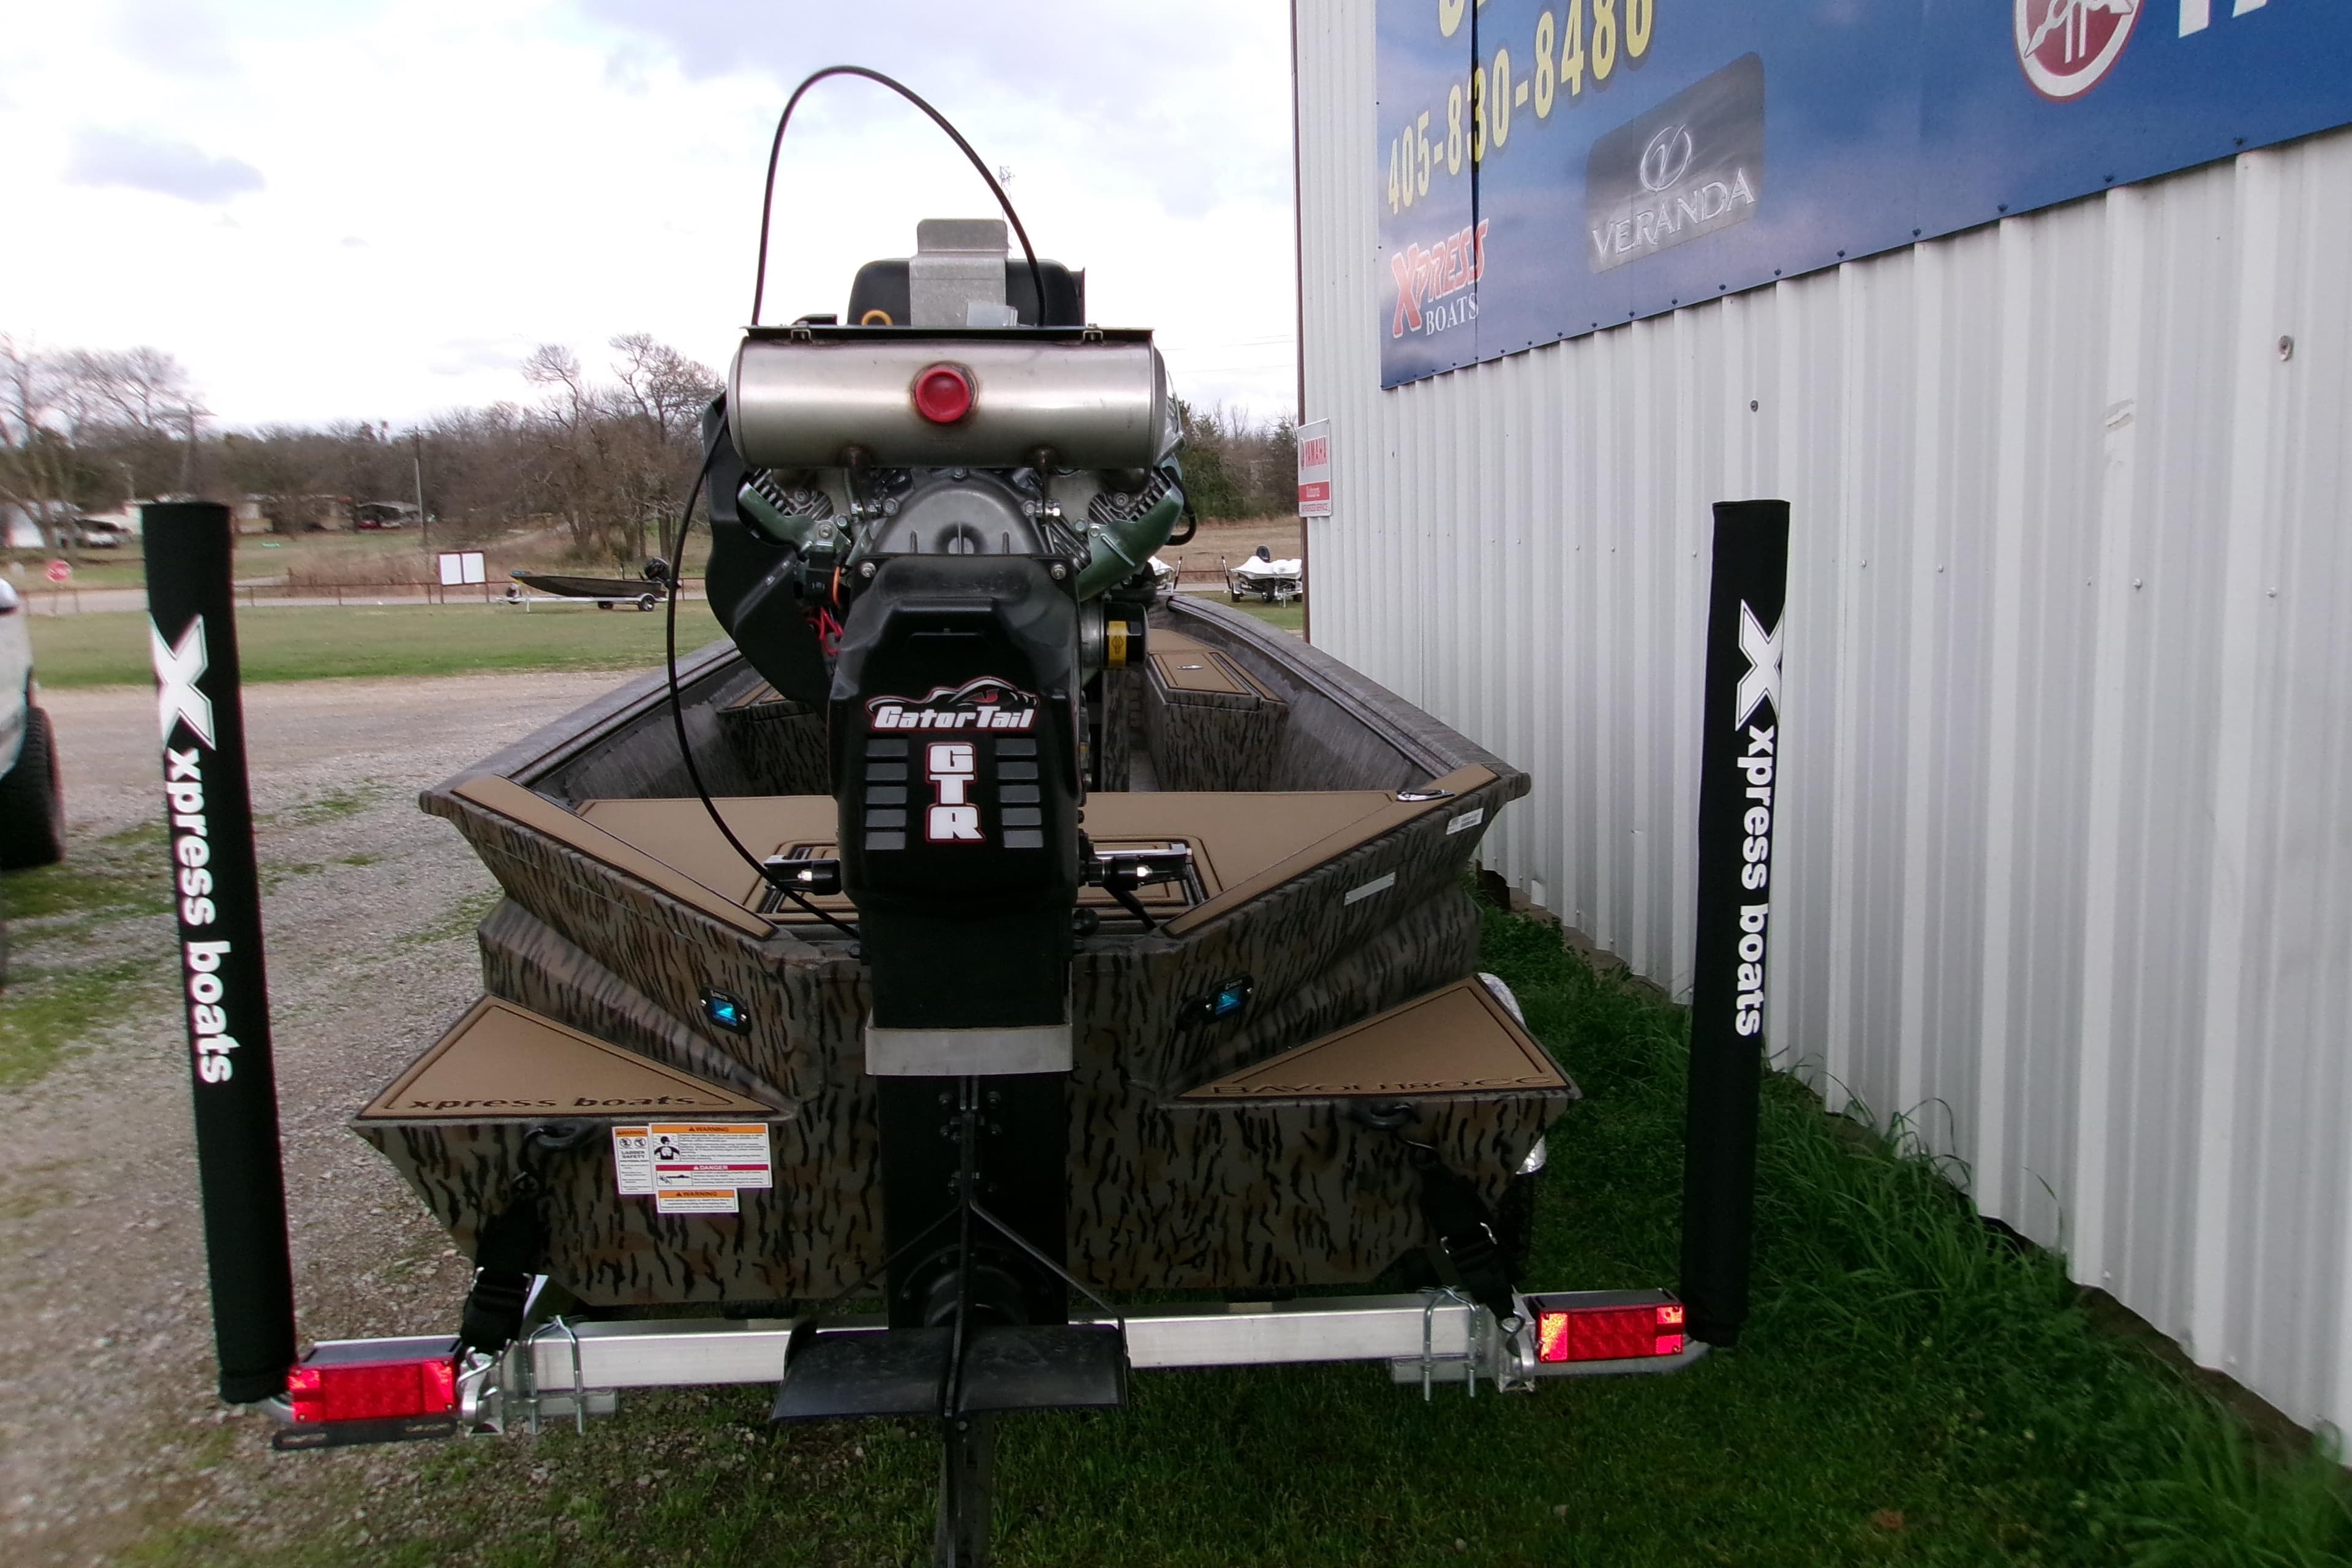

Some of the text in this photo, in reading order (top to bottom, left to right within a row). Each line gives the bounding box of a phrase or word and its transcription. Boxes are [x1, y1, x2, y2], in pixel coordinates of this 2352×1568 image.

[1592, 167, 1756, 256] VERANDA
[1391, 218, 1490, 339] XPRESS
[1426, 292, 1479, 336] BOATS
[874, 705, 1035, 728] GatorTail
[165, 747, 217, 926] xpress
[1737, 725, 1776, 891] xpress
[187, 940, 241, 1084] boats
[1735, 903, 1769, 1037] boats
[410, 1095, 695, 1110] xpress boats
